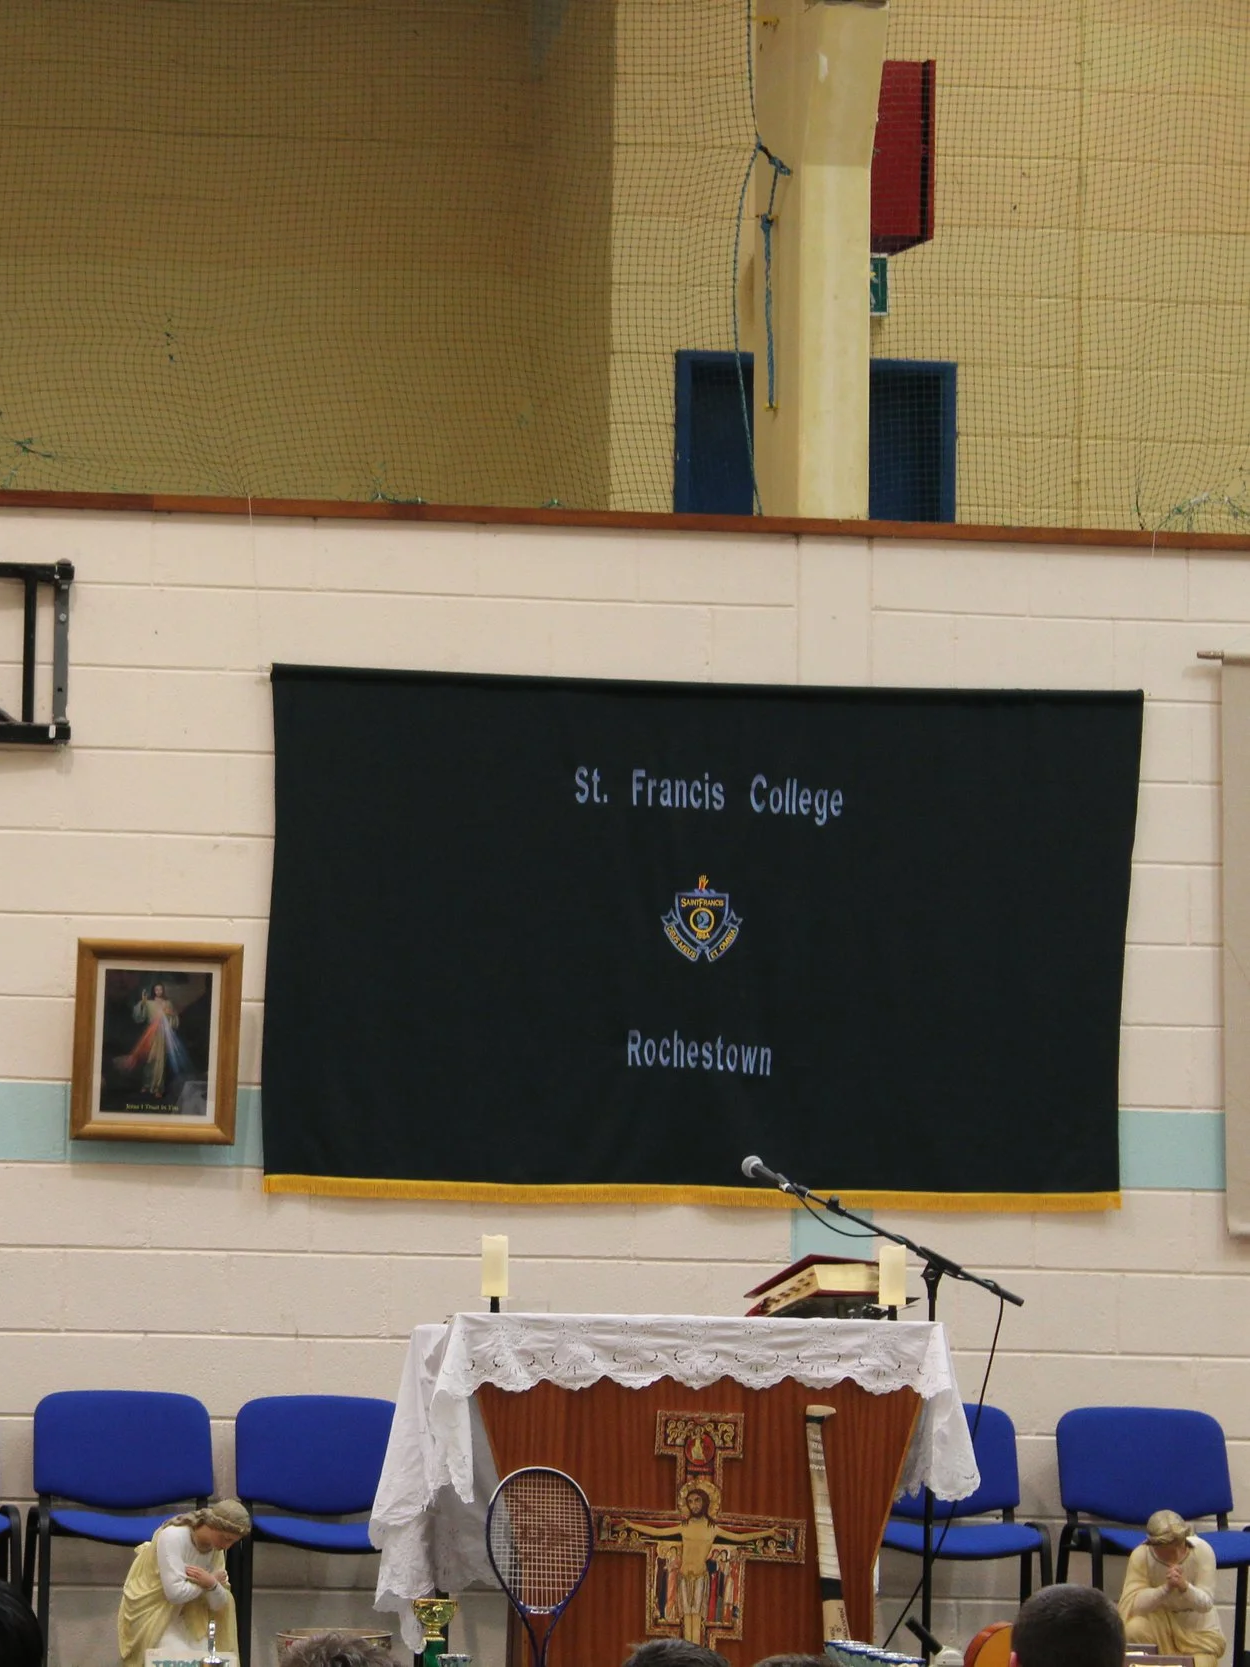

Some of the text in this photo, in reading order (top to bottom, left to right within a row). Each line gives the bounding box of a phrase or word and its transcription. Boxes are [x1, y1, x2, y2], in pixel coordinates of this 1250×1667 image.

[574, 766, 844, 826] St. Francis College
[677, 941, 697, 959] MEUS
[709, 928, 737, 960] ET OMNIA
[626, 1028, 773, 1077] Rochestown
